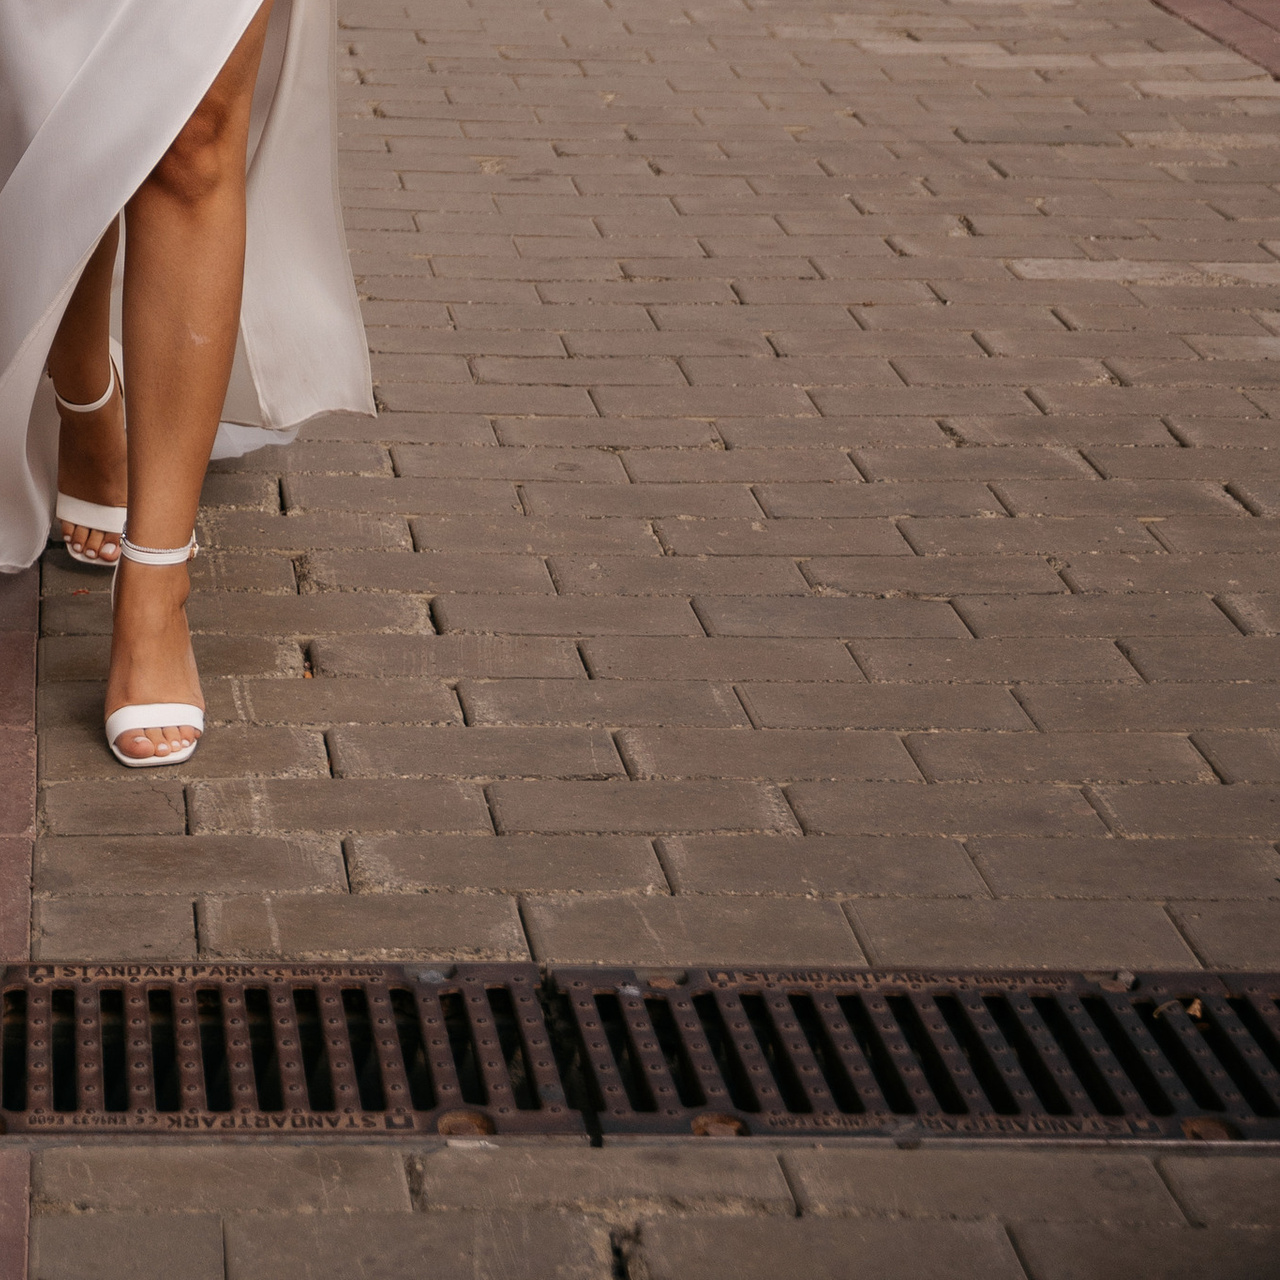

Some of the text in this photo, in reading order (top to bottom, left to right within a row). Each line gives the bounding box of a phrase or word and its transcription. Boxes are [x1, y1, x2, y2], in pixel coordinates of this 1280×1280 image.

[62, 965, 256, 977] STANDARTPARK
[742, 971, 939, 983] STANDARTPARK
[167, 1114, 377, 1129] STANDARTPARK
[908, 1118, 1126, 1132] STANDARTPAR
